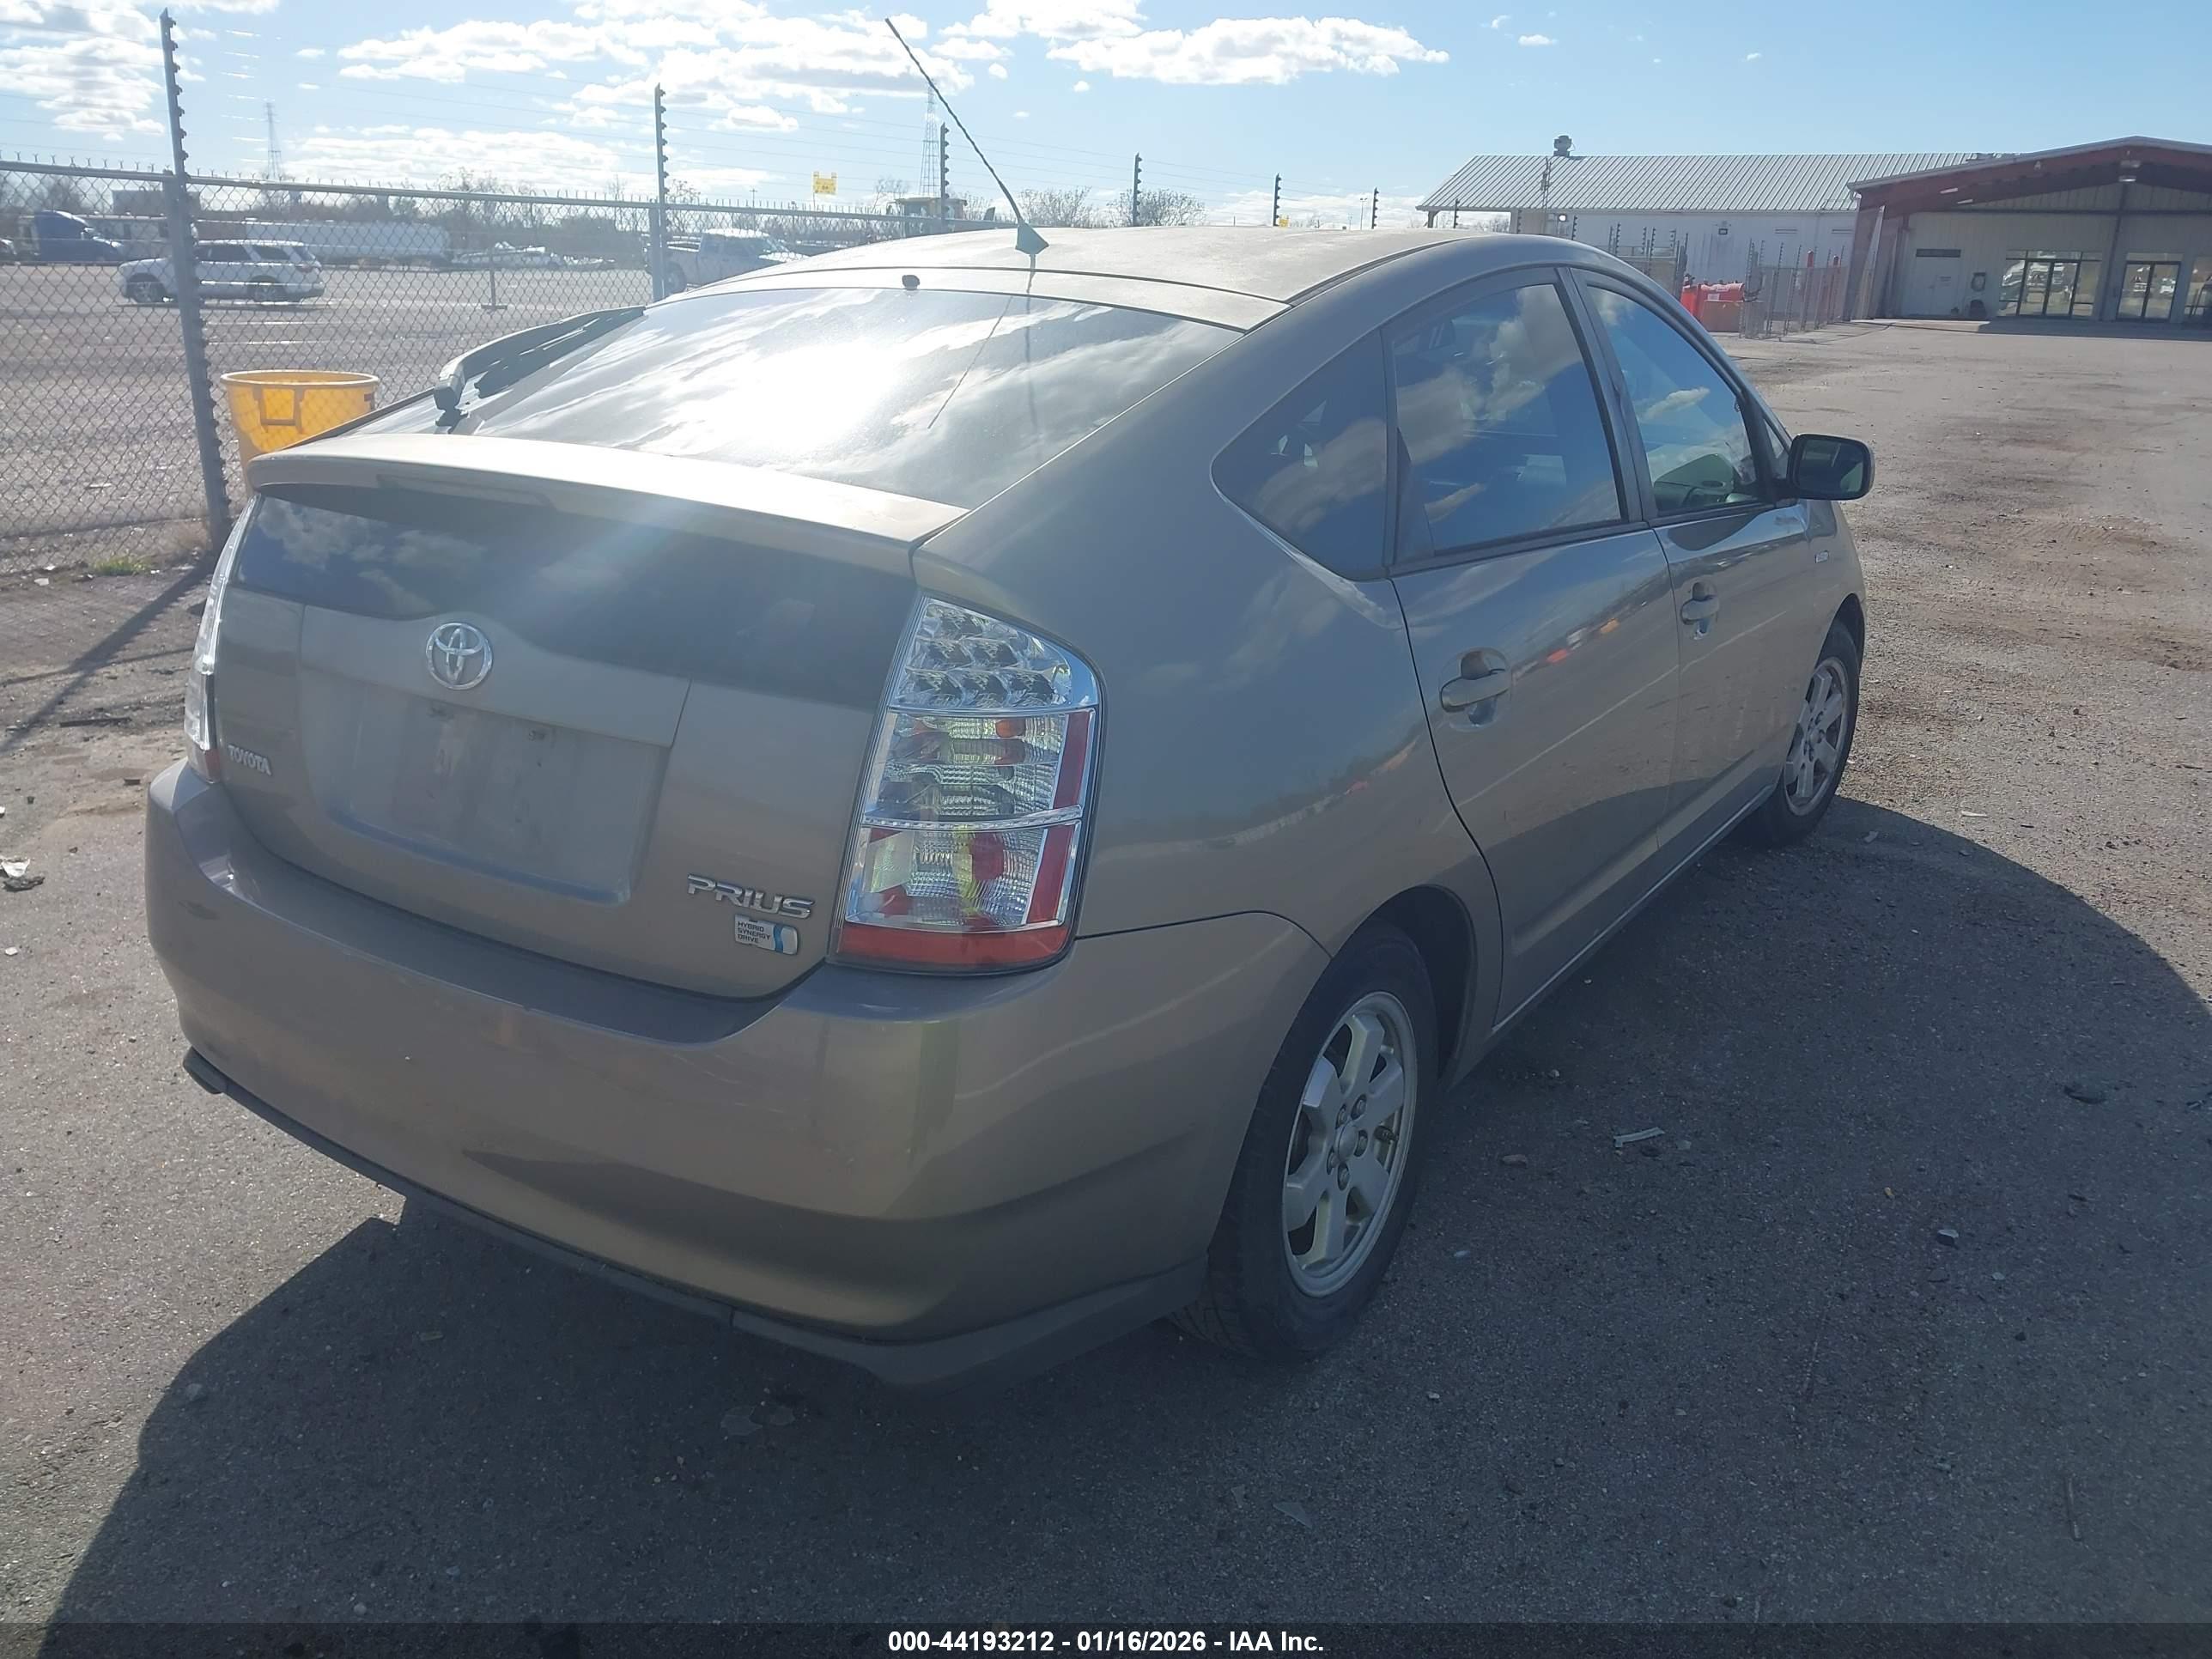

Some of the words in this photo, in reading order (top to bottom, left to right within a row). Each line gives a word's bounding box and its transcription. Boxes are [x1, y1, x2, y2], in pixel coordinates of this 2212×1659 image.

[228, 744, 271, 775] TOYOTA
[688, 874, 814, 919] PRIUS
[738, 921, 764, 933] HYBRID
[738, 927, 770, 940] SYNERGY
[738, 933, 759, 944] DRIVE
